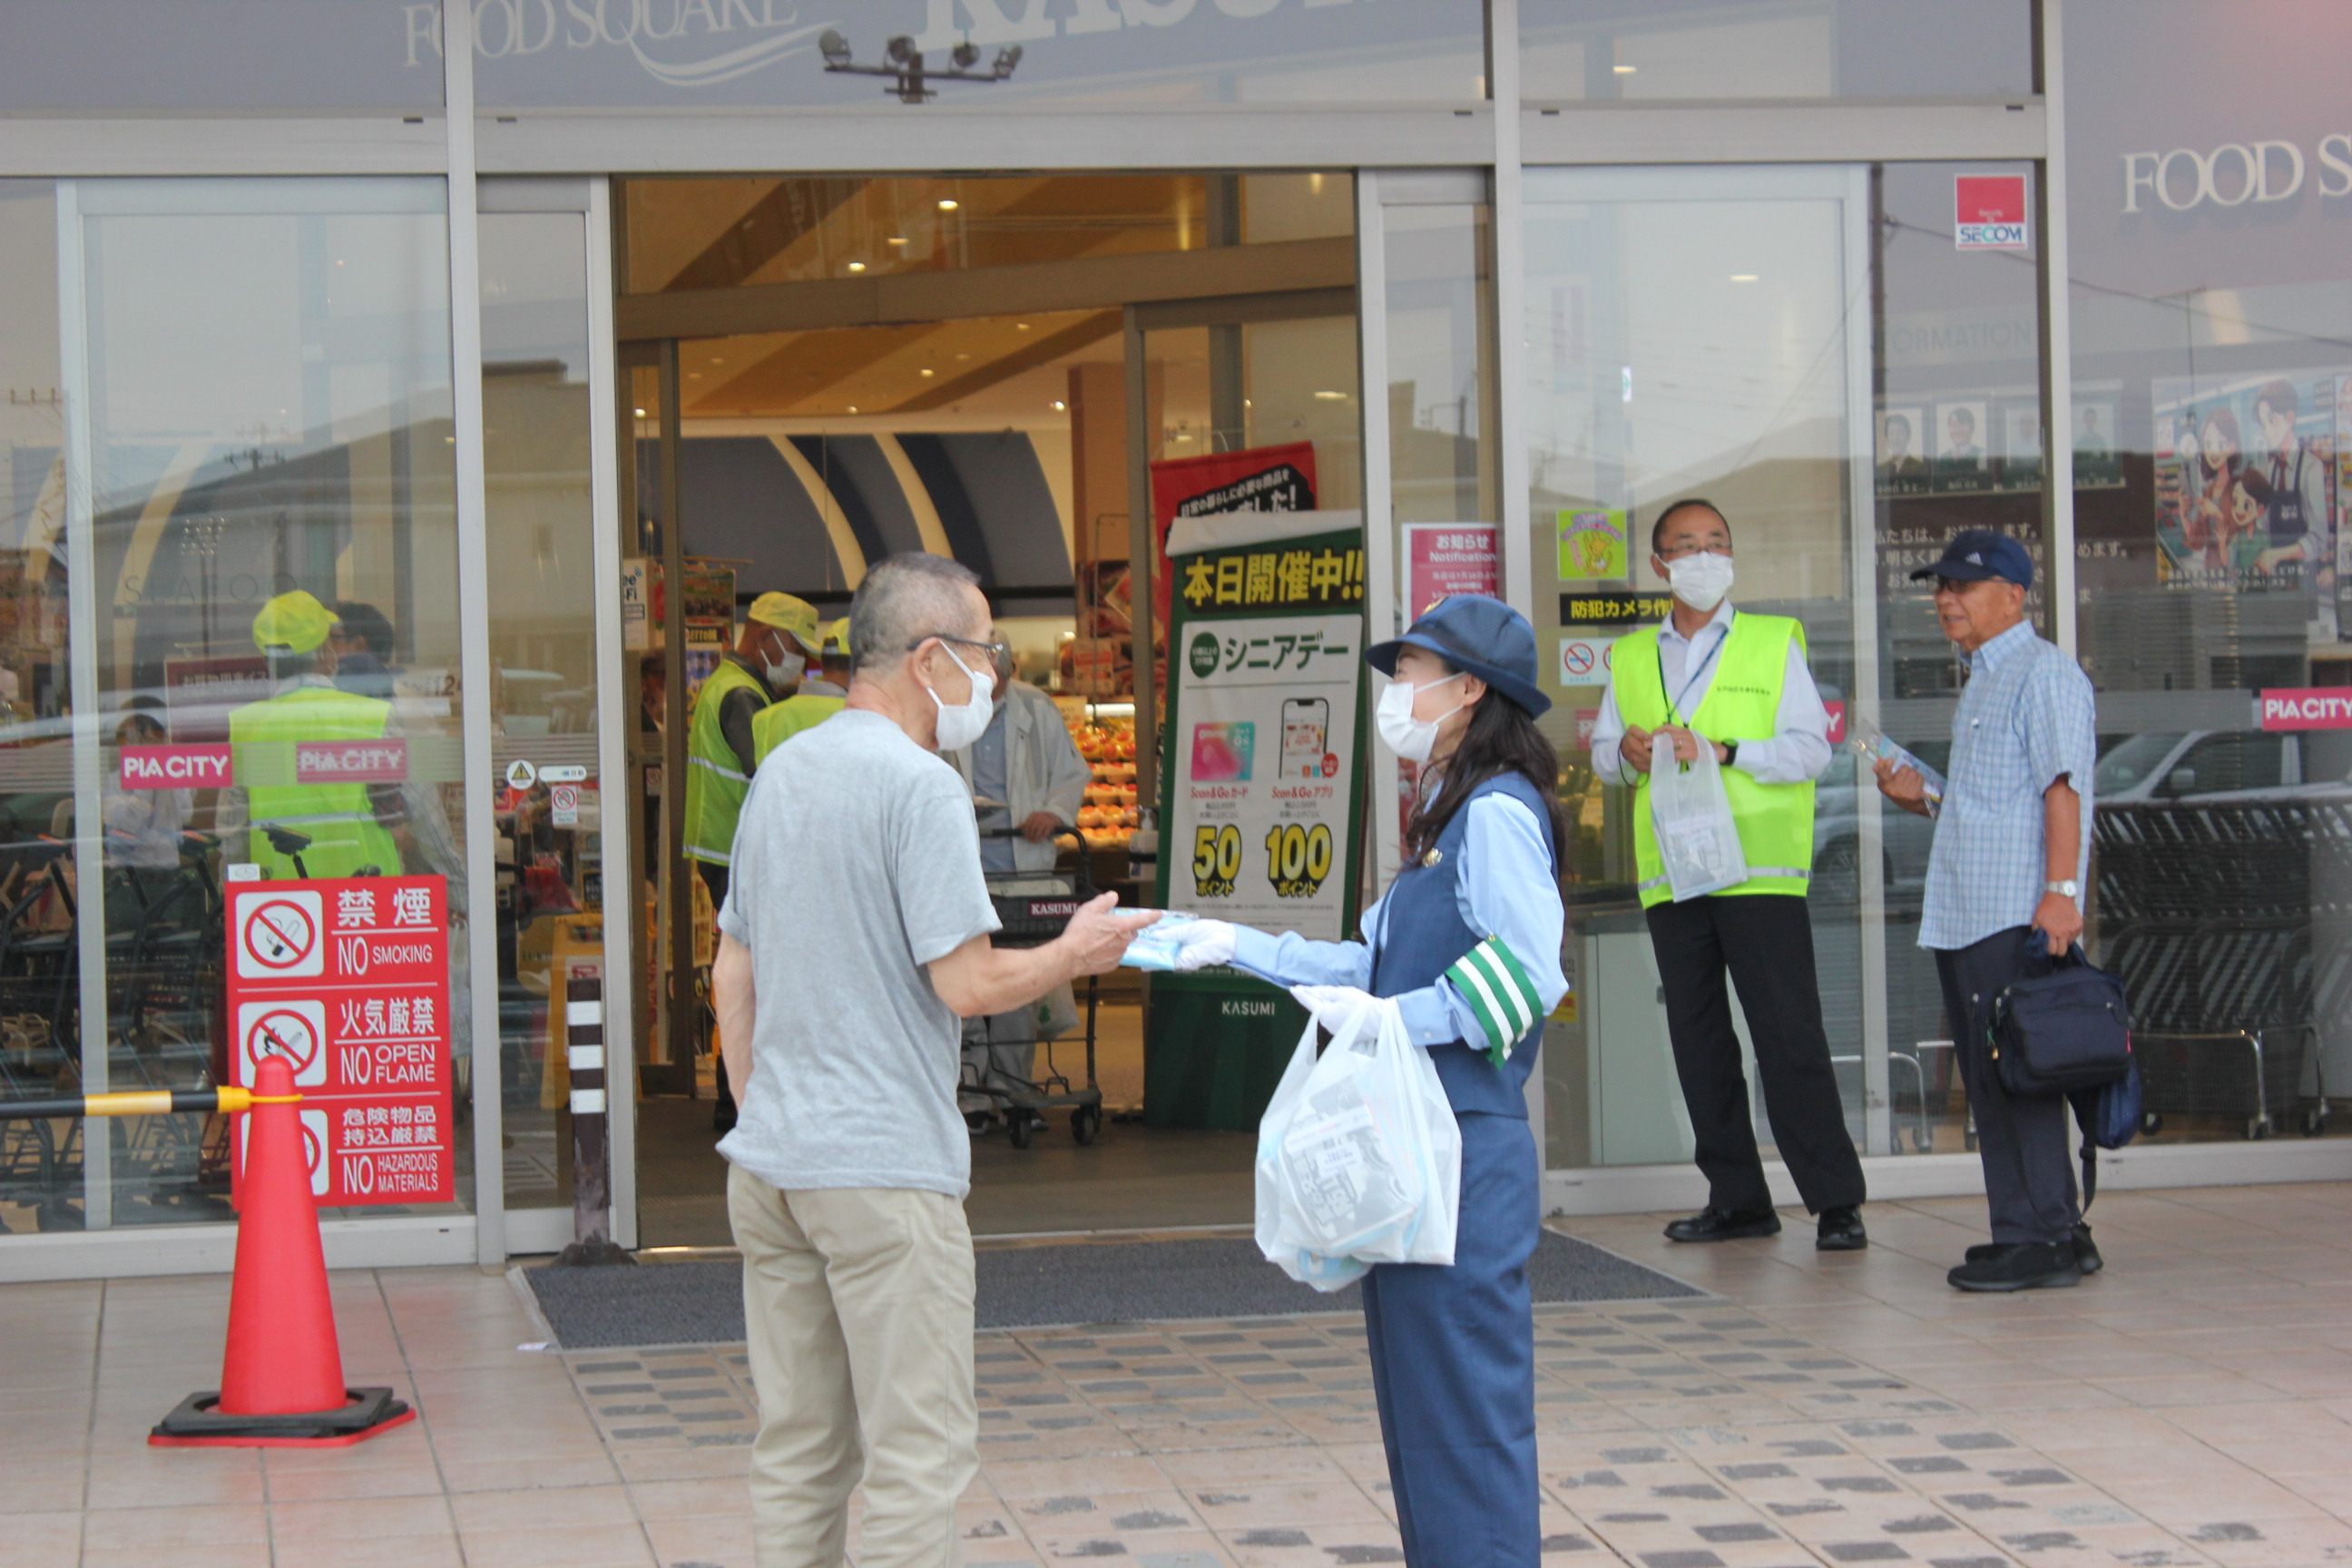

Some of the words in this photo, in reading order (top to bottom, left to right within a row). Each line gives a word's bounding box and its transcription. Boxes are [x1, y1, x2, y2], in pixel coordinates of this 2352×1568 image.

[2120, 140, 2305, 213] FOOD
[1960, 226, 2023, 242] SECOM
[1436, 534, 1490, 550] お知らせ
[1429, 550, 1496, 563] Notification
[1183, 548, 1364, 607] 本日開催中!!
[1571, 598, 1674, 620] 防犯カメラ作
[1225, 630, 1349, 672] シニアデー
[2266, 698, 2301, 720] PIA
[123, 757, 164, 779] PIA
[165, 755, 229, 779] CITY
[339, 749, 403, 770] CITY
[1193, 824, 1242, 881] 50
[1265, 823, 1333, 881] 100
[1196, 880, 1235, 897] ポイント
[1278, 880, 1318, 897] ポイント
[1031, 903, 1078, 916] KASUMI
[338, 936, 368, 975] NO
[372, 945, 433, 965] SMOKING
[340, 996, 436, 1037] 火気厳禁
[1222, 1001, 1275, 1015] KASUMI
[340, 1045, 372, 1085] NO
[375, 1044, 436, 1063] OPEN
[376, 1063, 436, 1083] FLAME
[343, 1105, 436, 1126] 危険物品
[343, 1125, 437, 1146] 持込厳禁
[343, 1154, 374, 1194] NO
[377, 1152, 438, 1172] HAZARDOUS
[378, 1172, 438, 1193] MATERIALS
